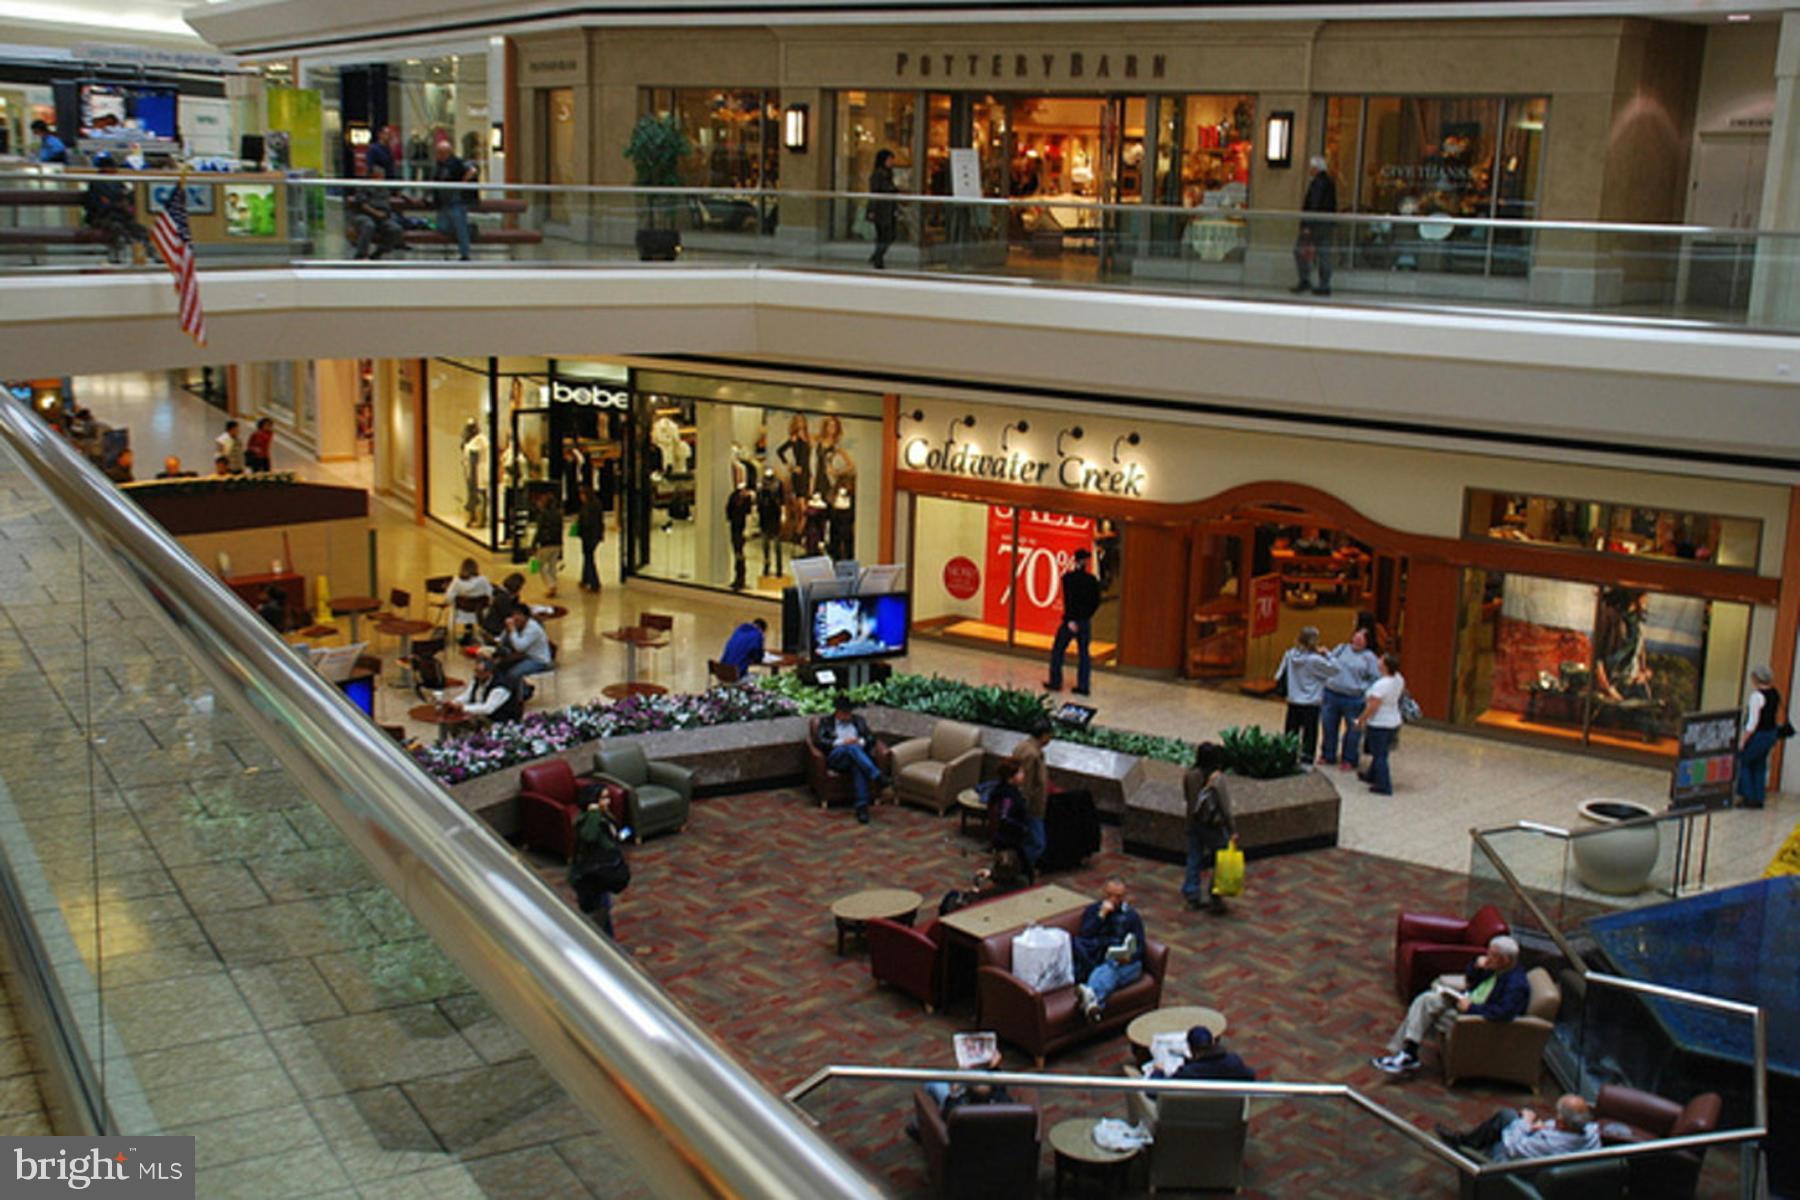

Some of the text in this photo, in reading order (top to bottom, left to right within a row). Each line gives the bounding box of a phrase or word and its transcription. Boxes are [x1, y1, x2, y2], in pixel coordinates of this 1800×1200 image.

[896, 52, 1166, 79] POTTERY BARN
[553, 381, 628, 410] bebe
[904, 438, 1145, 497] Coldwater Creek
